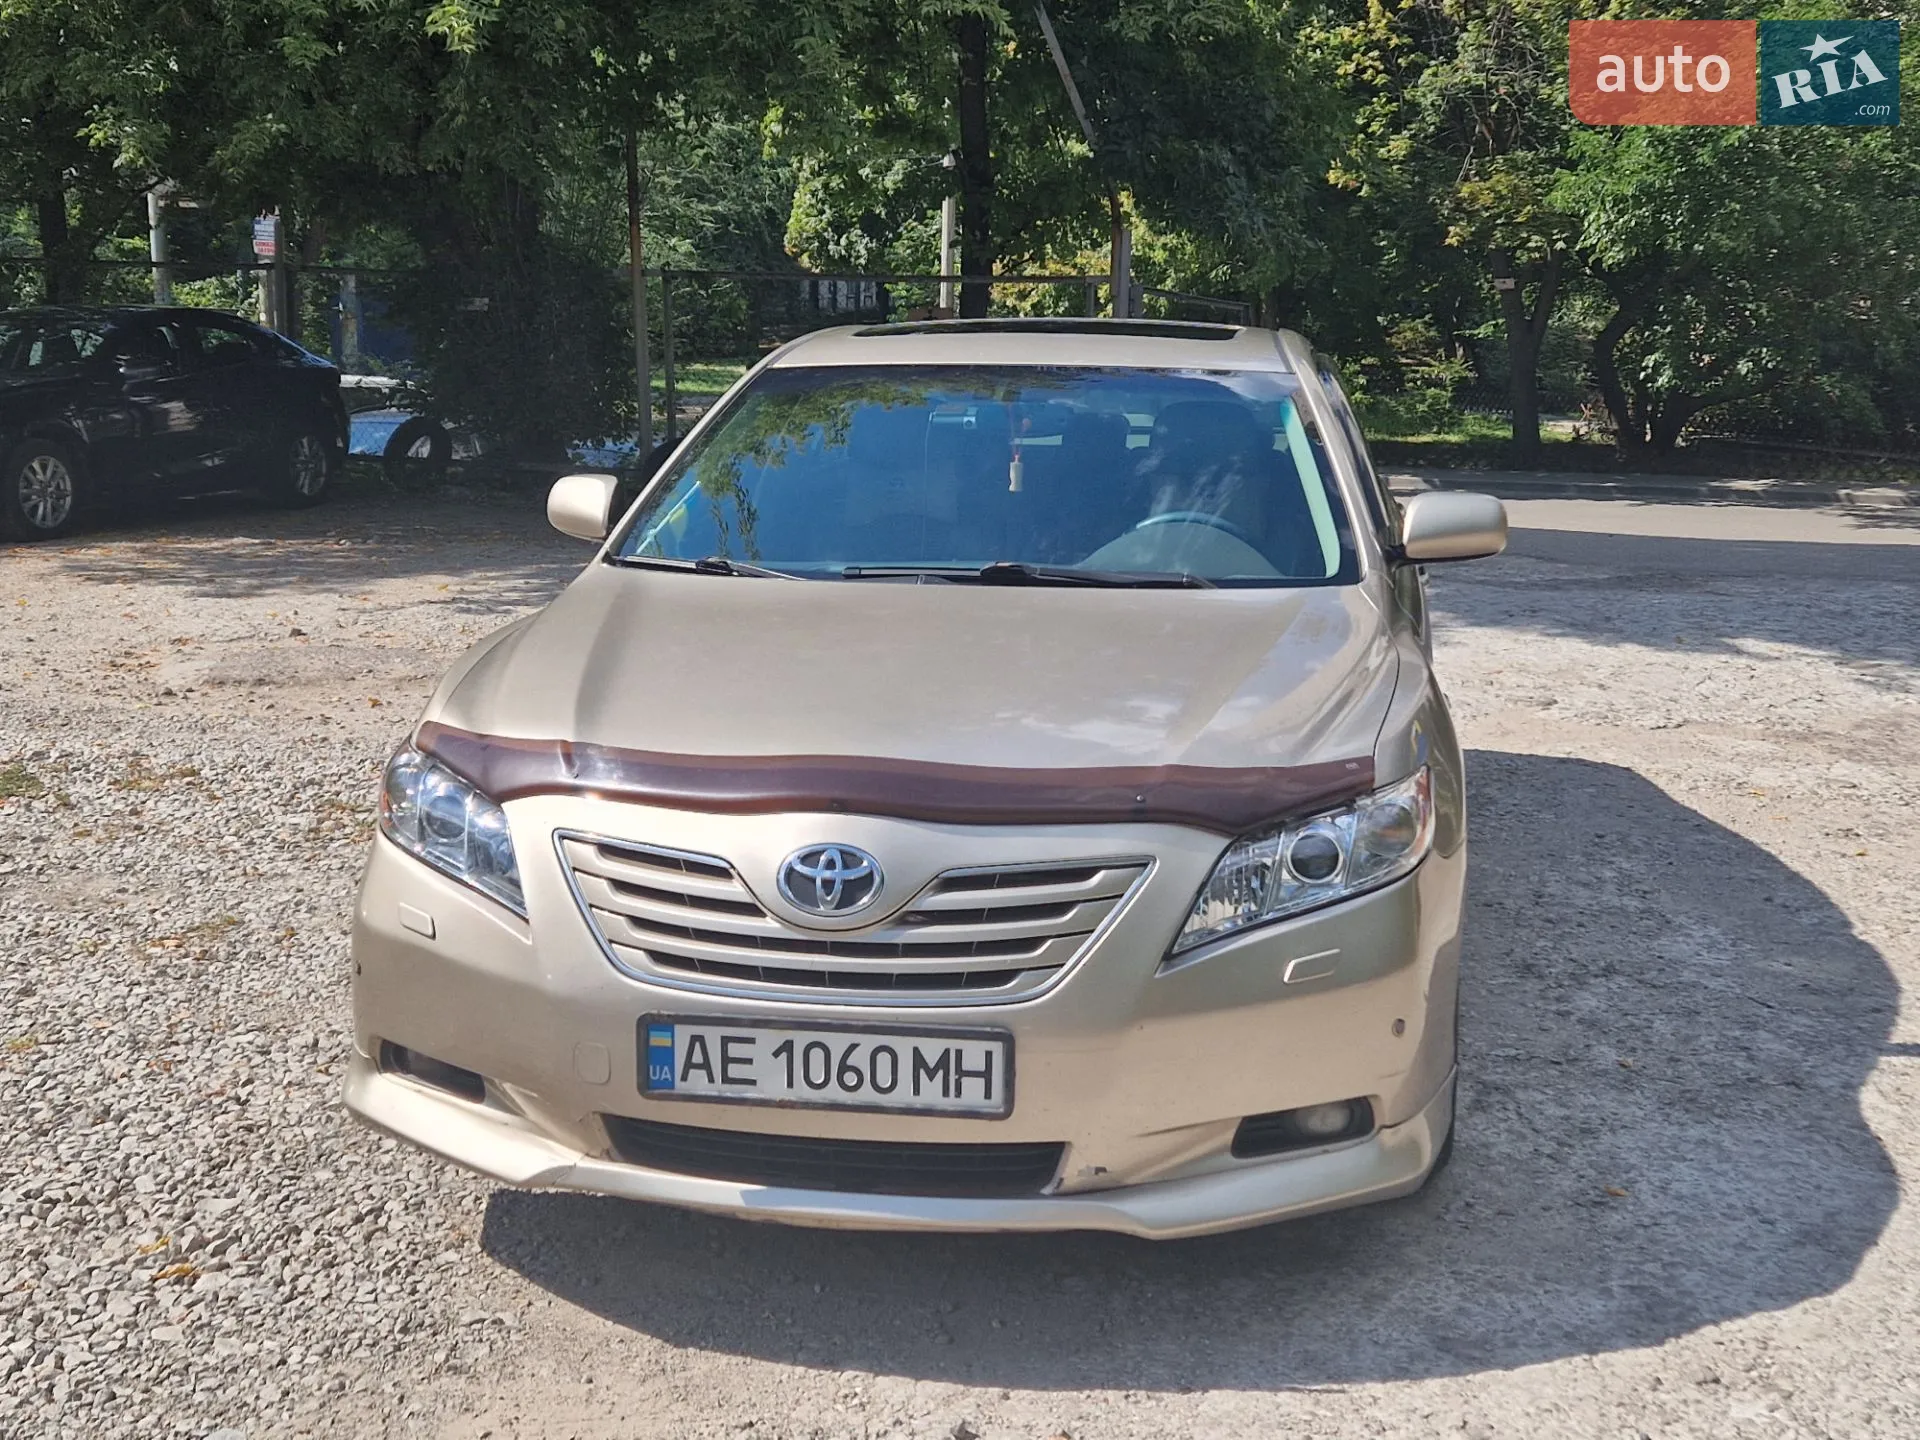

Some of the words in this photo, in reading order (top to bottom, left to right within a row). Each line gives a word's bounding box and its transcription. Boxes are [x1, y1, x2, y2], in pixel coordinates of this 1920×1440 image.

[649, 1065, 672, 1081] UA
[680, 1034, 757, 1086] AE
[772, 1039, 898, 1095] 1060
[912, 1046, 993, 1100] MH
